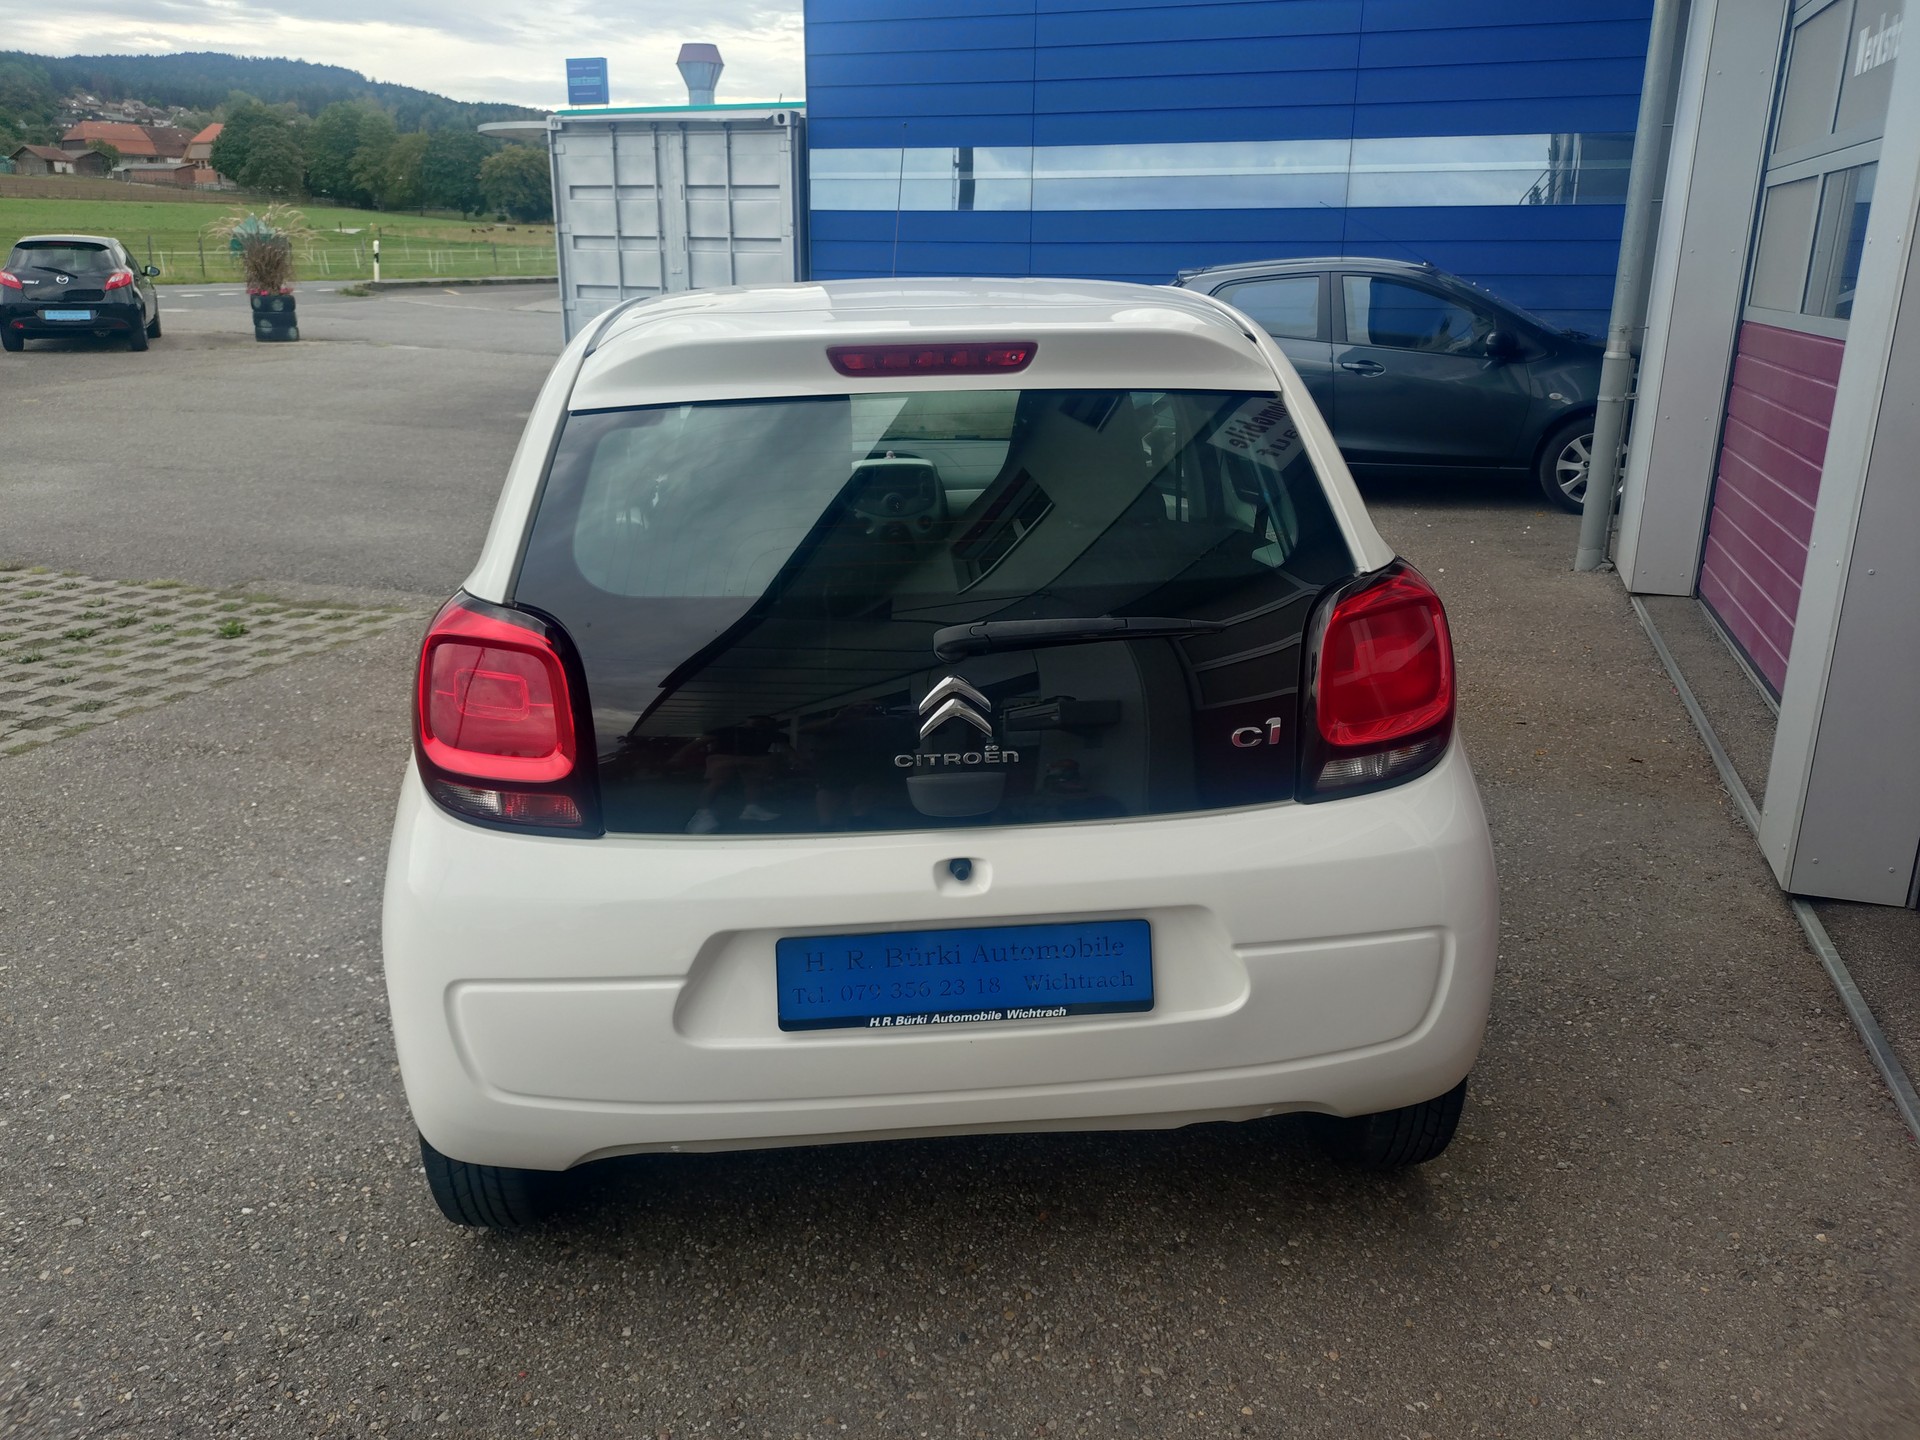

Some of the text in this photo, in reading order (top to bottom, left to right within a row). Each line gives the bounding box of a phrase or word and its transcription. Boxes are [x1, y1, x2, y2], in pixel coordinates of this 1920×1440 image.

[805, 935, 1125, 973] H. R. Bürki Automobile
[792, 970, 1135, 1004] Tel. 079 356 23 18 Wichtrach
[930, 1010, 1003, 1024] Automobile
[1006, 1006, 1067, 1020] Wichtrach
